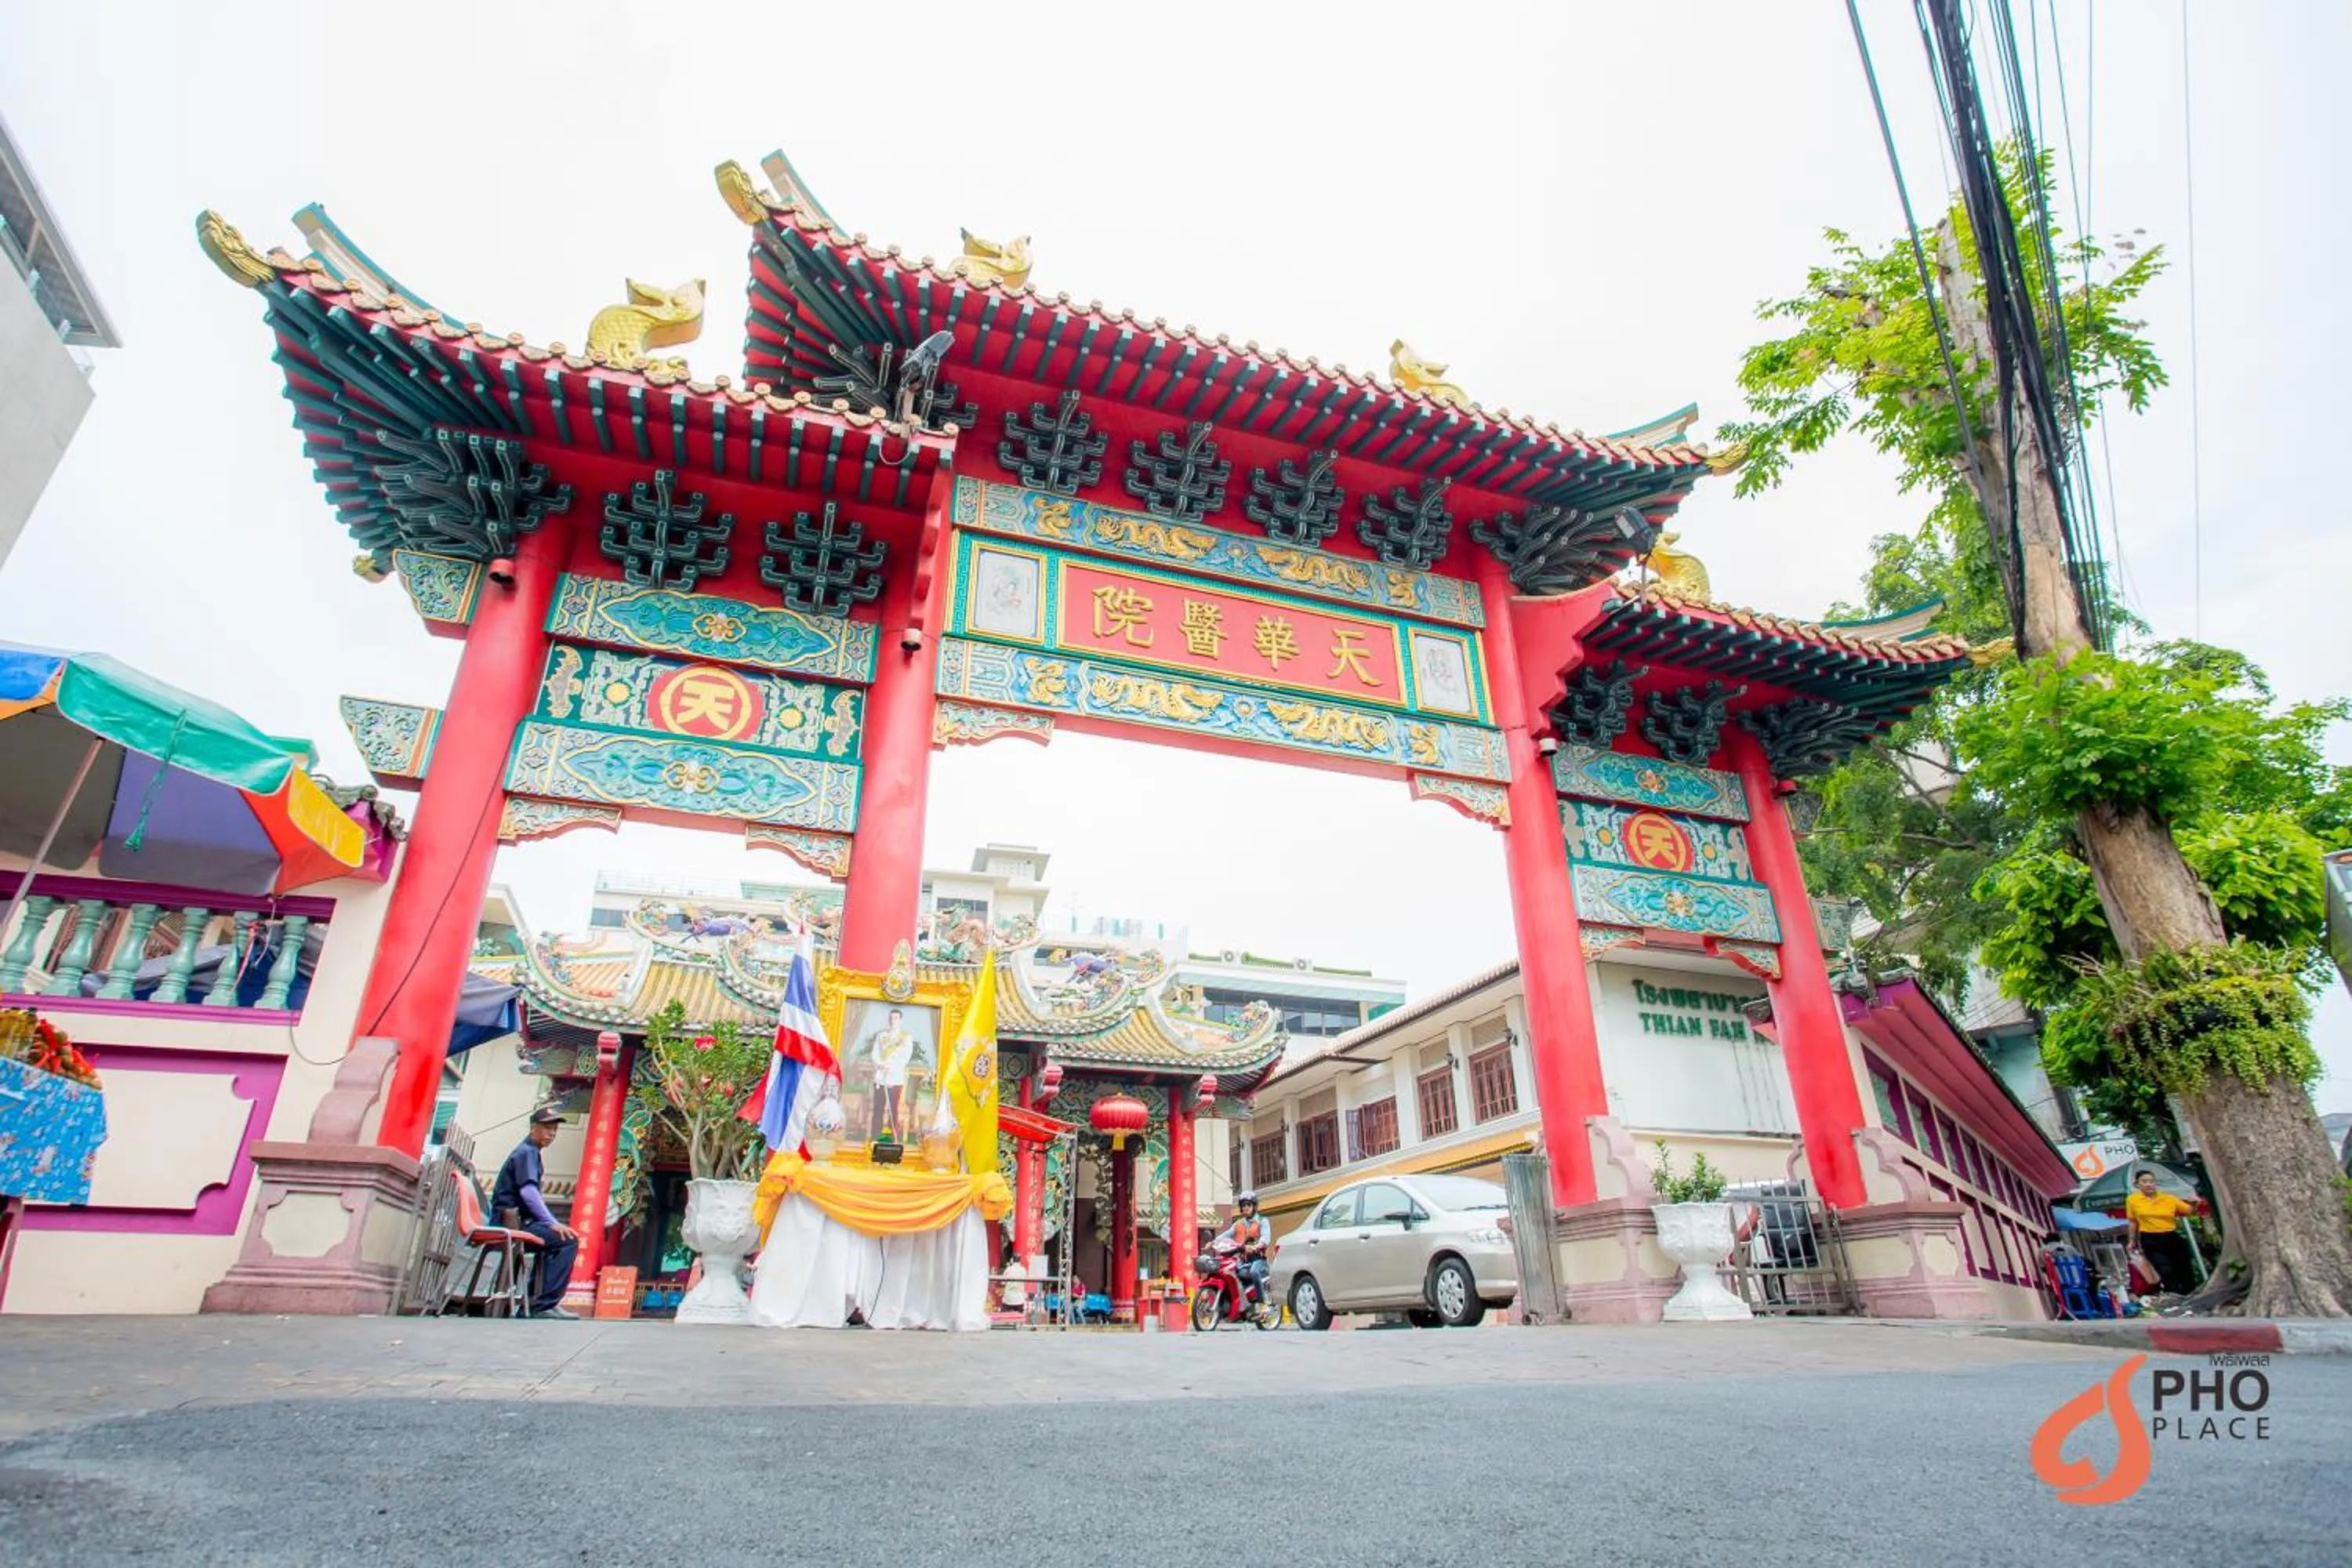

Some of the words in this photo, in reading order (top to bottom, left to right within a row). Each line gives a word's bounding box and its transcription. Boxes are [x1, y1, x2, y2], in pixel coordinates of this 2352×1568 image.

[679, 681, 735, 731] 天
[1639, 826, 1677, 867] 天
[1639, 1011, 1703, 1036] THIAN
[1709, 1018, 1748, 1041] FAH
[2105, 1144, 2135, 1155] PHO
